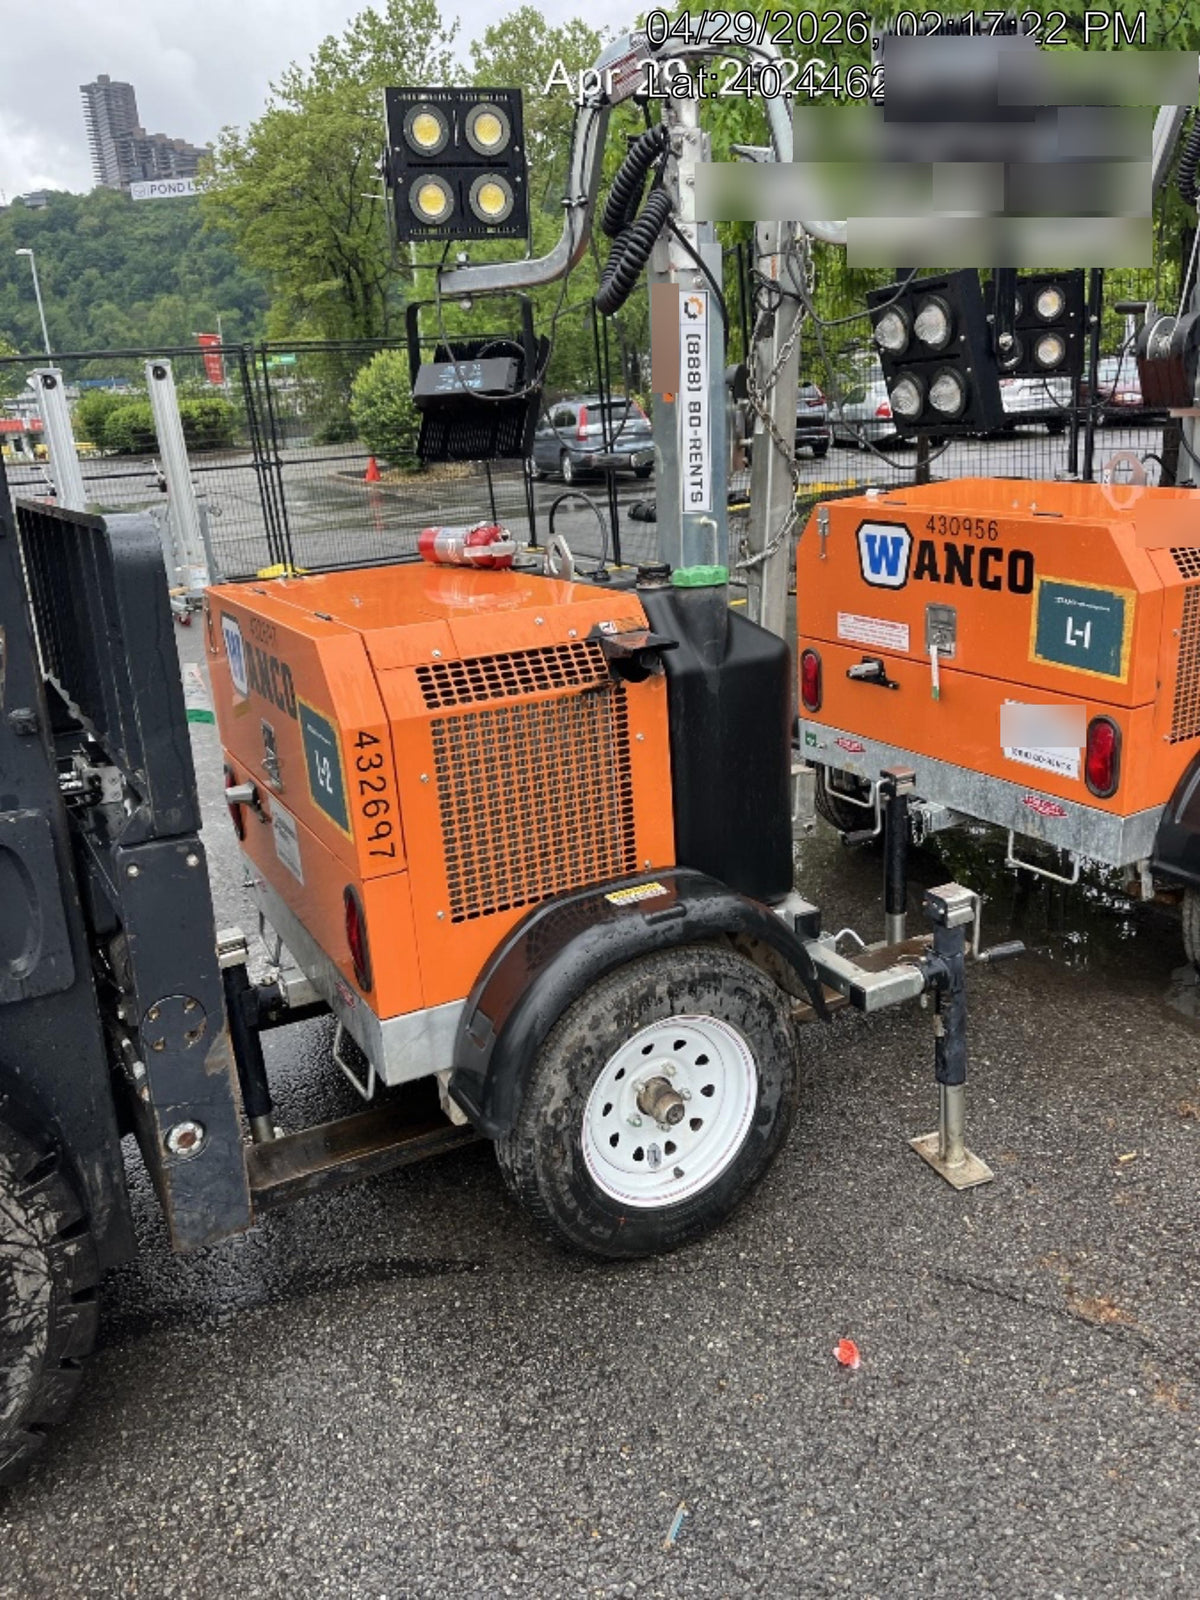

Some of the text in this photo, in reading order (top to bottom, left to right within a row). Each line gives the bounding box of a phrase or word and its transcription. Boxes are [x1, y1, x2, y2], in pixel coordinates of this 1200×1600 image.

[151, 182, 185, 194] POND
[685, 333, 704, 503] (888) 80-RENTS
[860, 526, 1035, 595] WANCO
[926, 514, 999, 542] 430956
[353, 730, 396, 858] 432697
